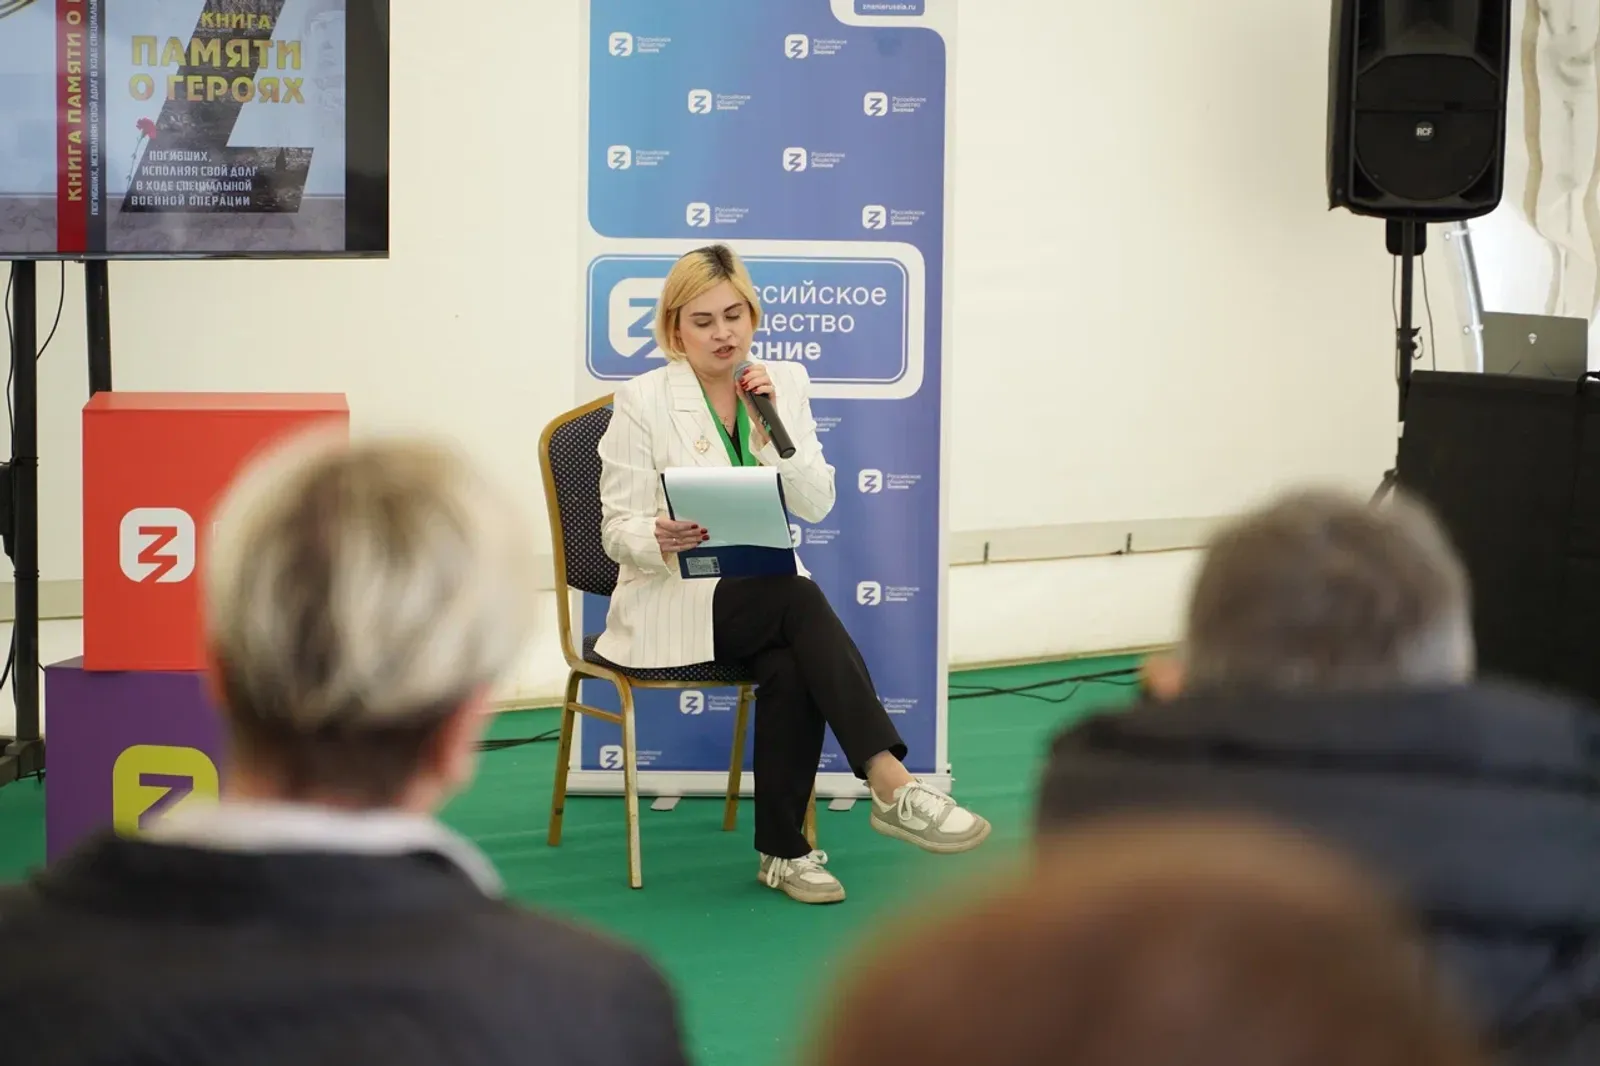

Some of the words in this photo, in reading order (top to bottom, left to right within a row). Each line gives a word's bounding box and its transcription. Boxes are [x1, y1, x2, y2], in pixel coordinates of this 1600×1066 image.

[66, 10, 82, 25] О
[201, 12, 271, 30] КНИГА
[132, 35, 302, 70] ПАМЯТИ
[67, 33, 82, 123] ПАМЯТИ
[90, 70, 98, 78] В
[129, 73, 155, 101] О
[167, 74, 305, 104] ГЕРОЯХ
[1416, 127, 1432, 136] RCF
[149, 150, 212, 163] ПОГИБШИХ,
[67, 130, 82, 201] КНИГА
[142, 165, 198, 177] ИСПОЛНЯЯ
[201, 163, 228, 177] СВОЙ
[230, 166, 258, 178] ДОЛГ
[136, 181, 144, 191] В
[146, 181, 174, 192] ХОДЕ
[176, 179, 252, 193] СПЕЦИАЛЬНОЙ
[131, 194, 185, 206] ВОЕННОЙ
[188, 195, 251, 207] ОПЕРАЦИИ
[750, 341, 821, 360] ание
